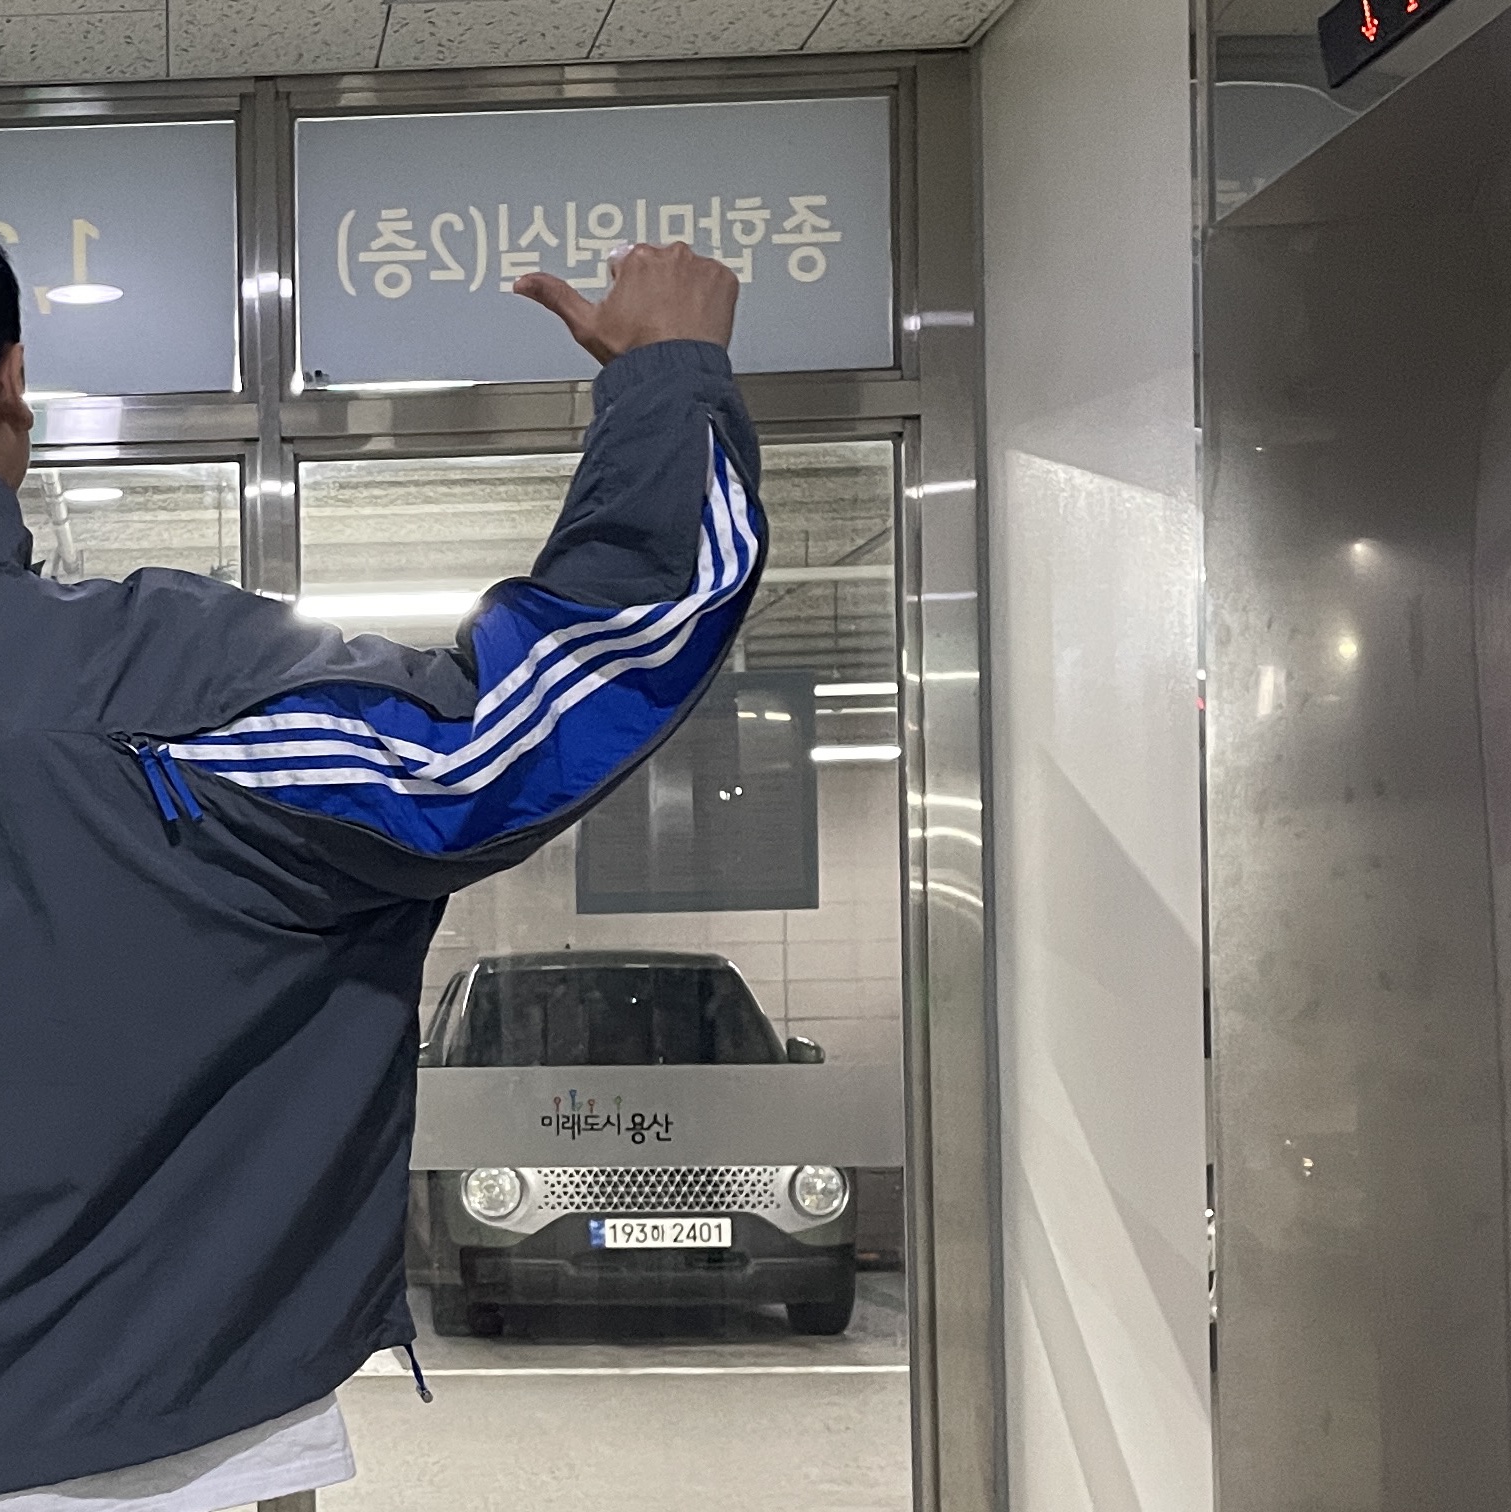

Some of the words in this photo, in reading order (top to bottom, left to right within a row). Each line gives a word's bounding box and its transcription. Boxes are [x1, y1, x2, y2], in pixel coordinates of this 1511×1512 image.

[541, 1112, 621, 1141] 미래도시
[625, 1112, 674, 1145] 용산
[672, 1222, 723, 1244] 2401
